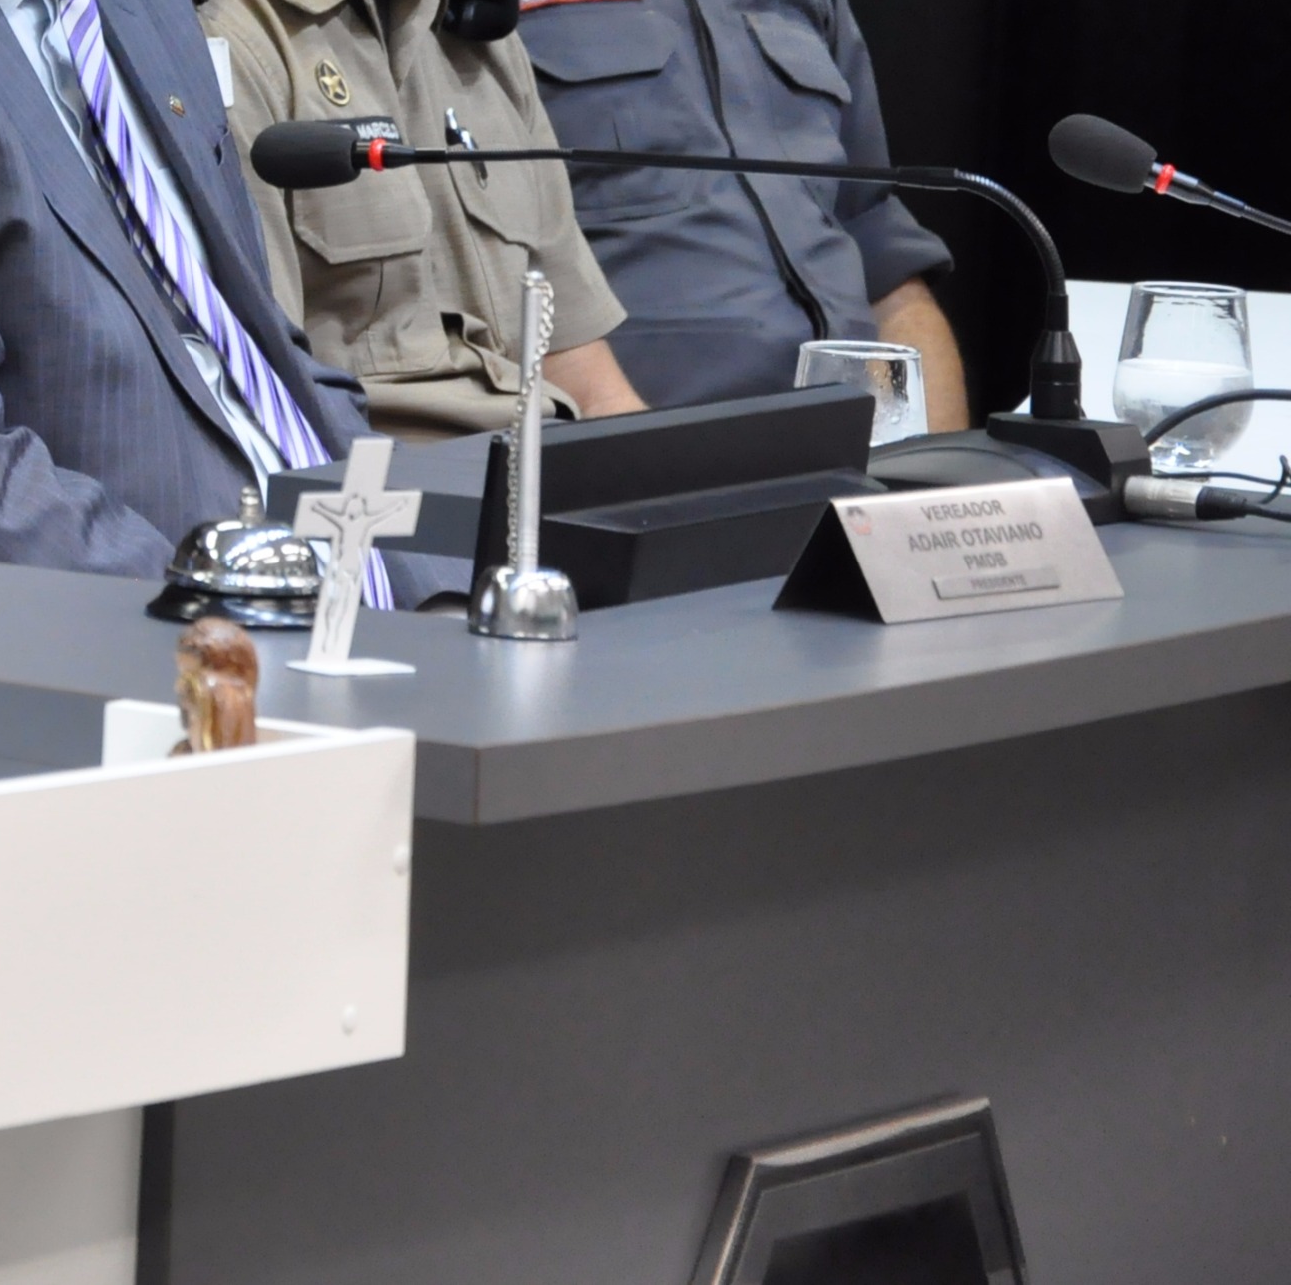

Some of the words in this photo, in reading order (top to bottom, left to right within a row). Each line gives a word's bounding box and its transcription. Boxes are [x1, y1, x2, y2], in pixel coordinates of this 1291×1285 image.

[920, 499, 1006, 522] VEREADOR
[908, 530, 961, 552] ADAIR
[961, 521, 1043, 547] OTAVIANO
[963, 551, 1008, 570] PMDB
